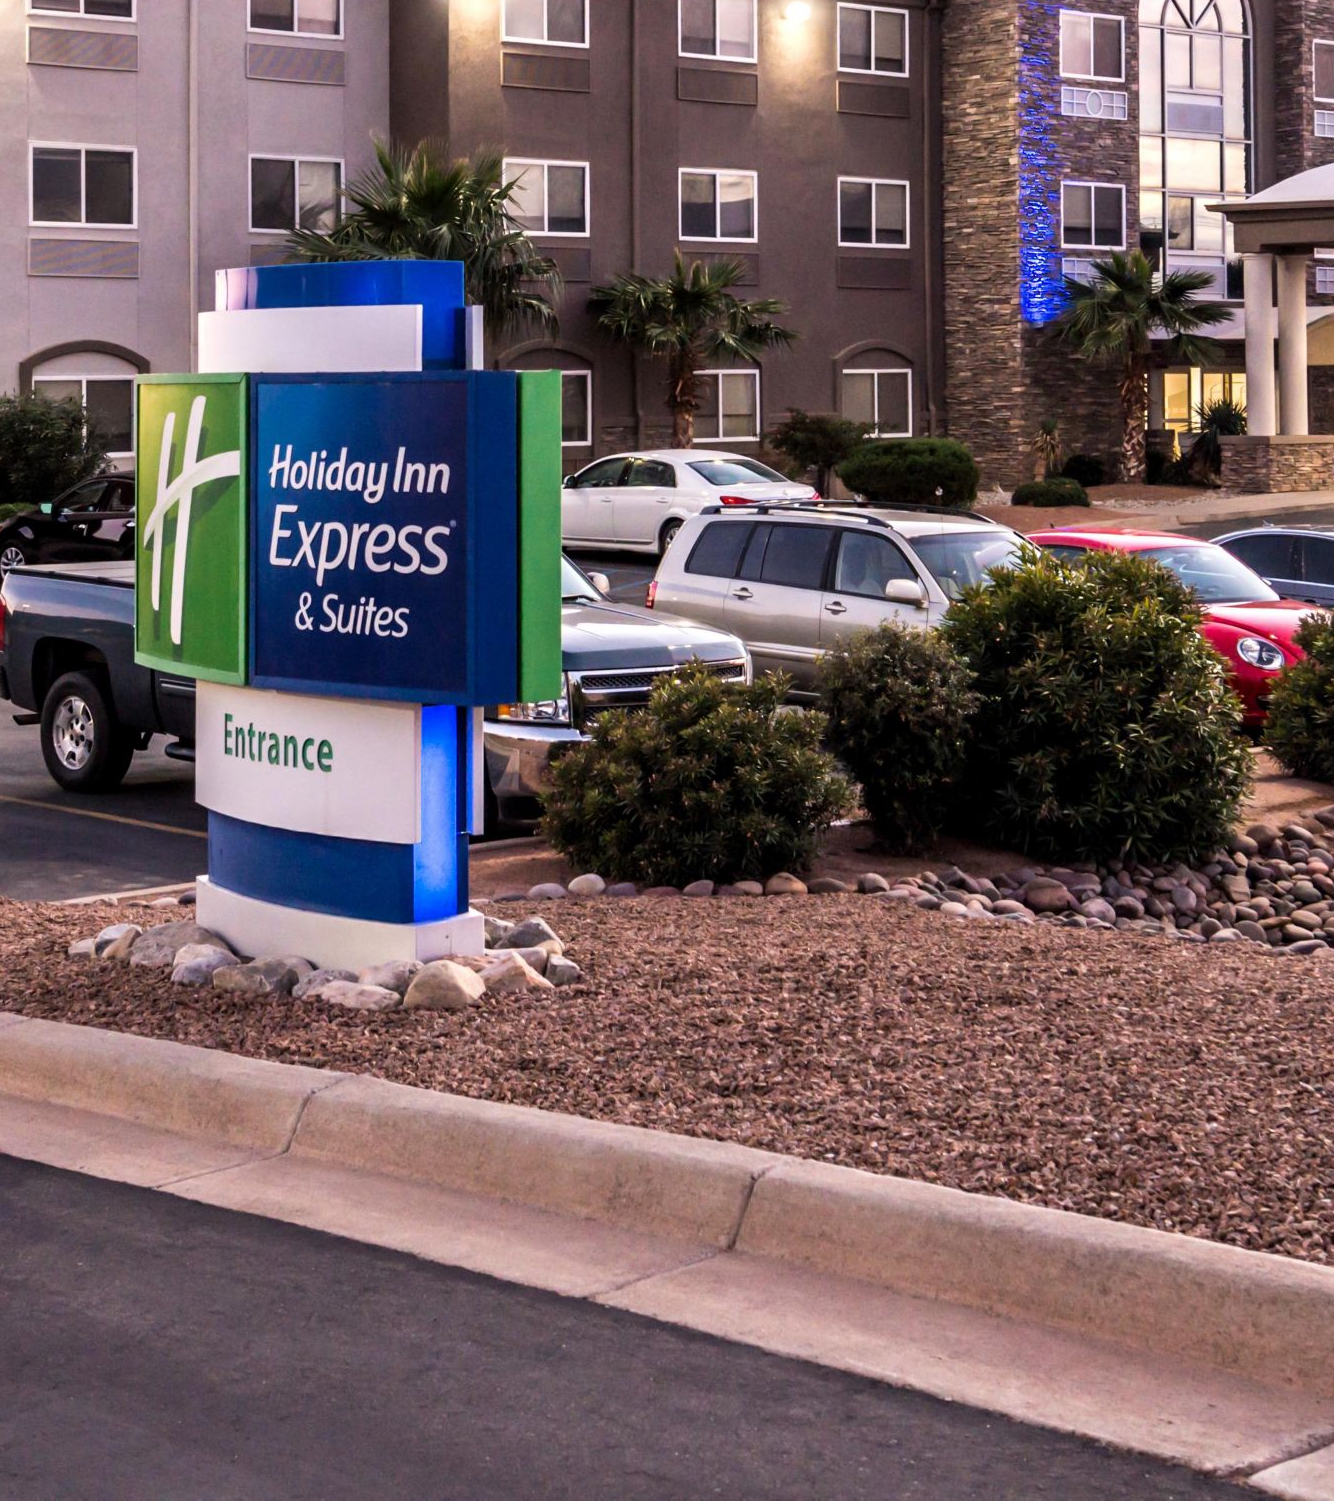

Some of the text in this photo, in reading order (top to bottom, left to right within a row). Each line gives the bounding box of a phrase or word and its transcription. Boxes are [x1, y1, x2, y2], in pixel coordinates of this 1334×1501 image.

[269, 444, 450, 504] Holiday Inn
[269, 504, 451, 587] Express
[295, 591, 410, 638] & Suites
[224, 713, 333, 772] Entrance
